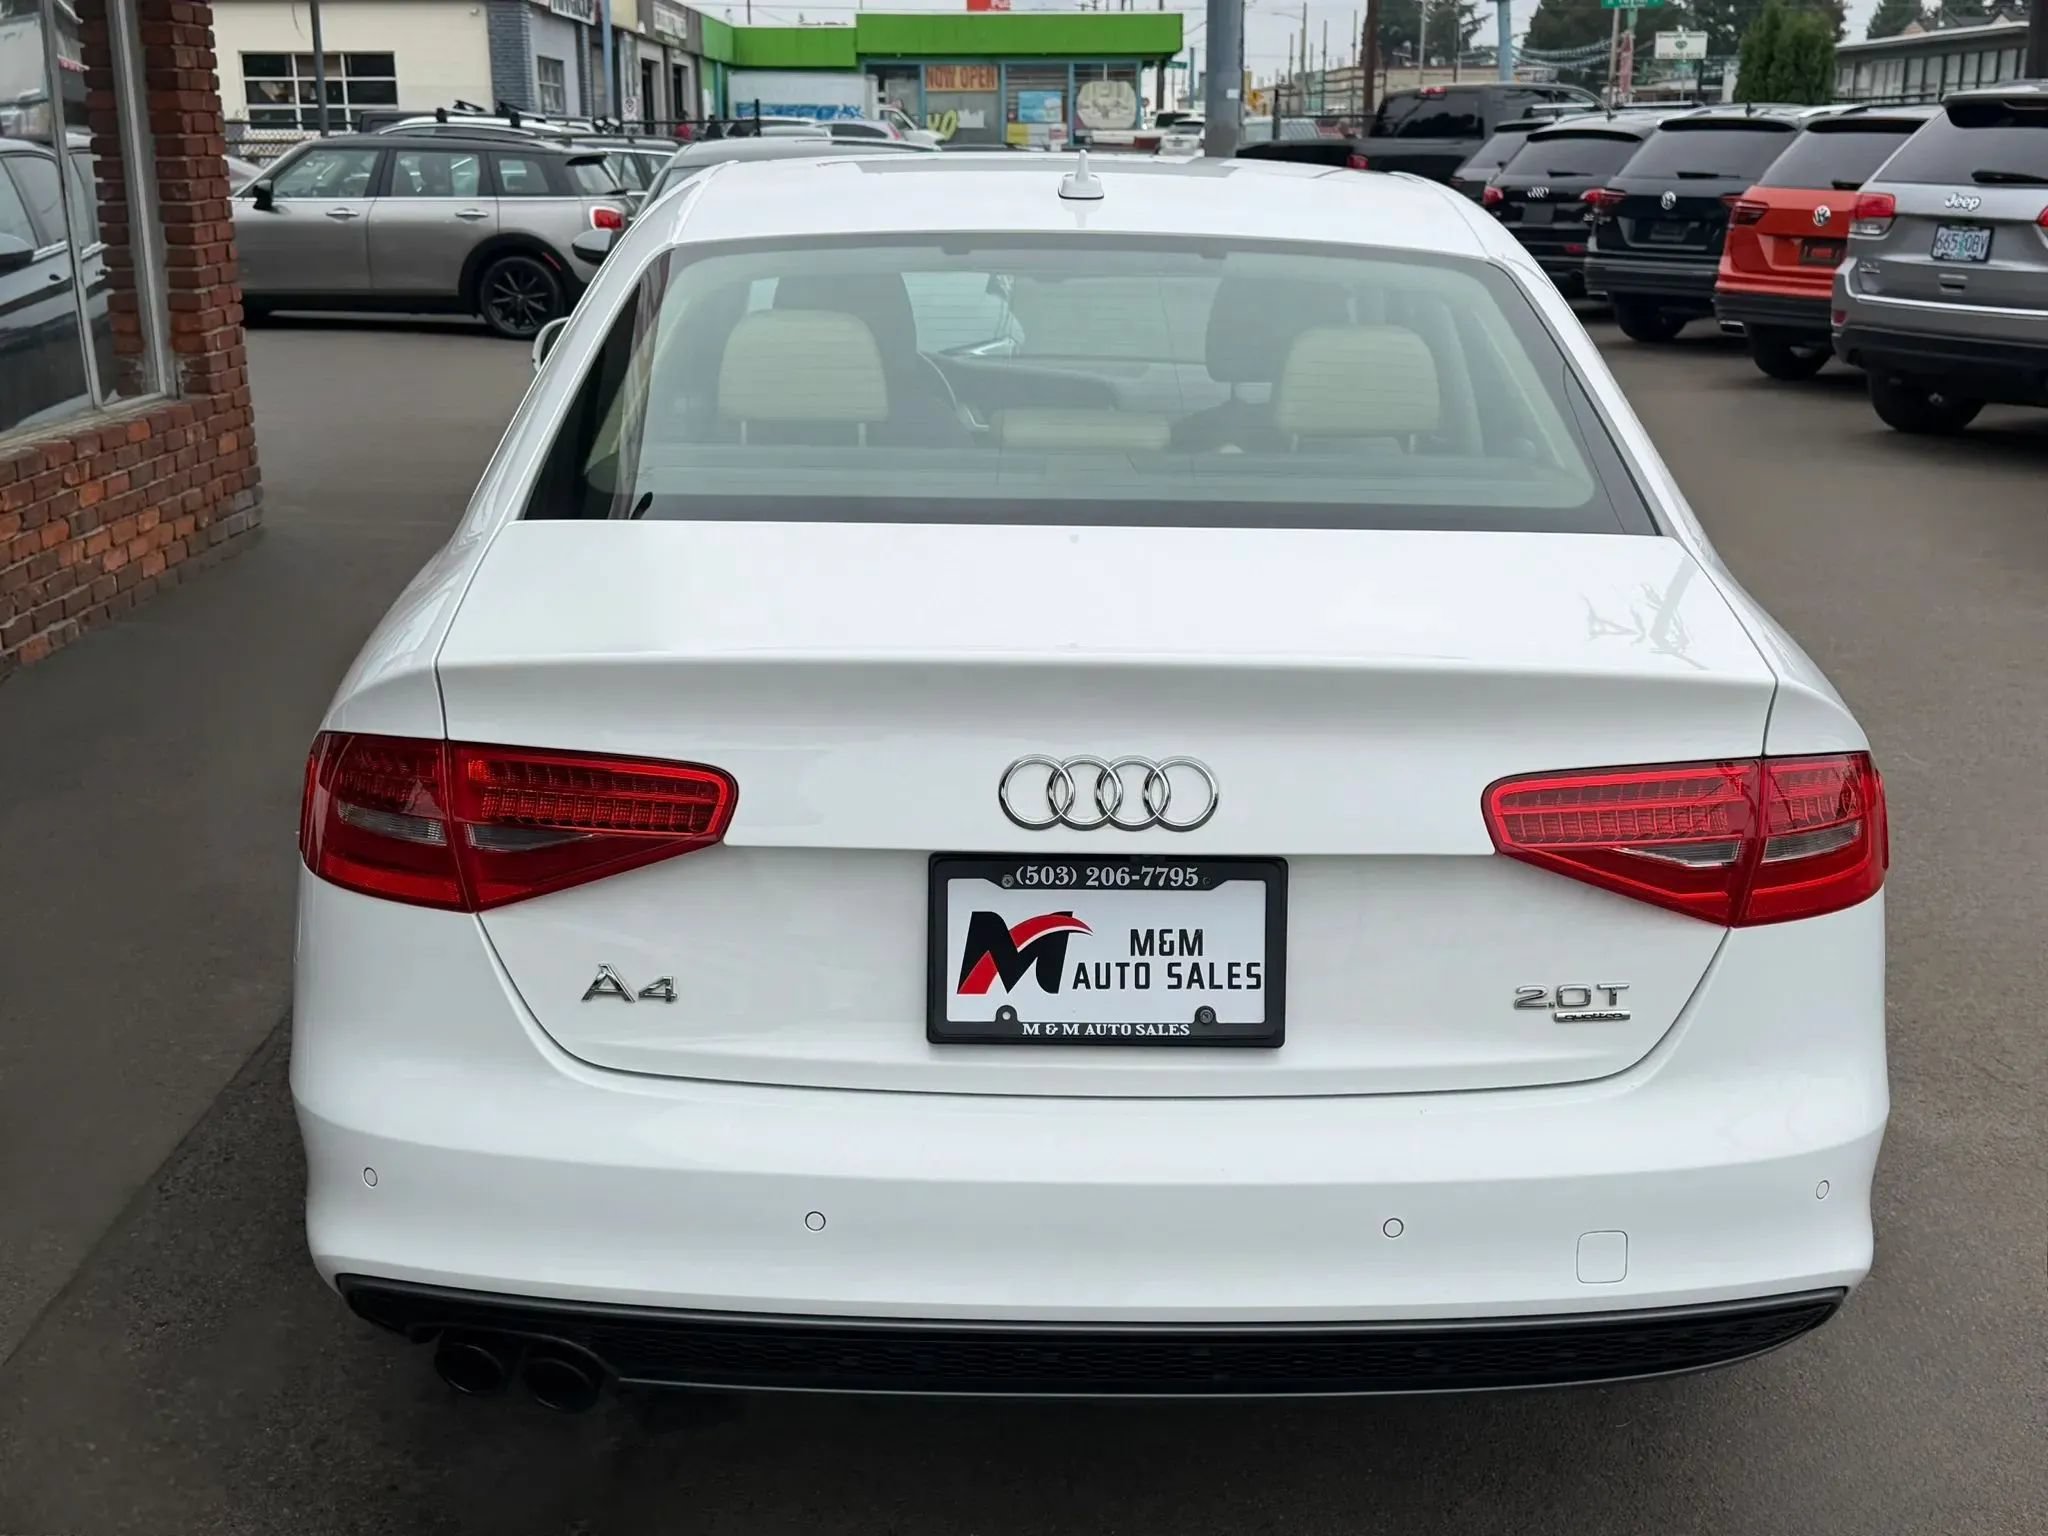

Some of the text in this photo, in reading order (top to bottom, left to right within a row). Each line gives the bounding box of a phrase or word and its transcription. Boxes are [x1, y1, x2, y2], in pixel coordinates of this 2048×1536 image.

[926, 66, 995, 89] NOW OPEN
[1945, 192, 1981, 212] Jeep
[1015, 865, 1199, 888] (503) 206-7795
[1130, 928, 1204, 957] M&M
[581, 963, 678, 1003] A4
[1072, 962, 1262, 990] AUTO SALES
[1513, 983, 1630, 1009] 2.0T
[1022, 1023, 1190, 1036] M & M AUTO SALES
